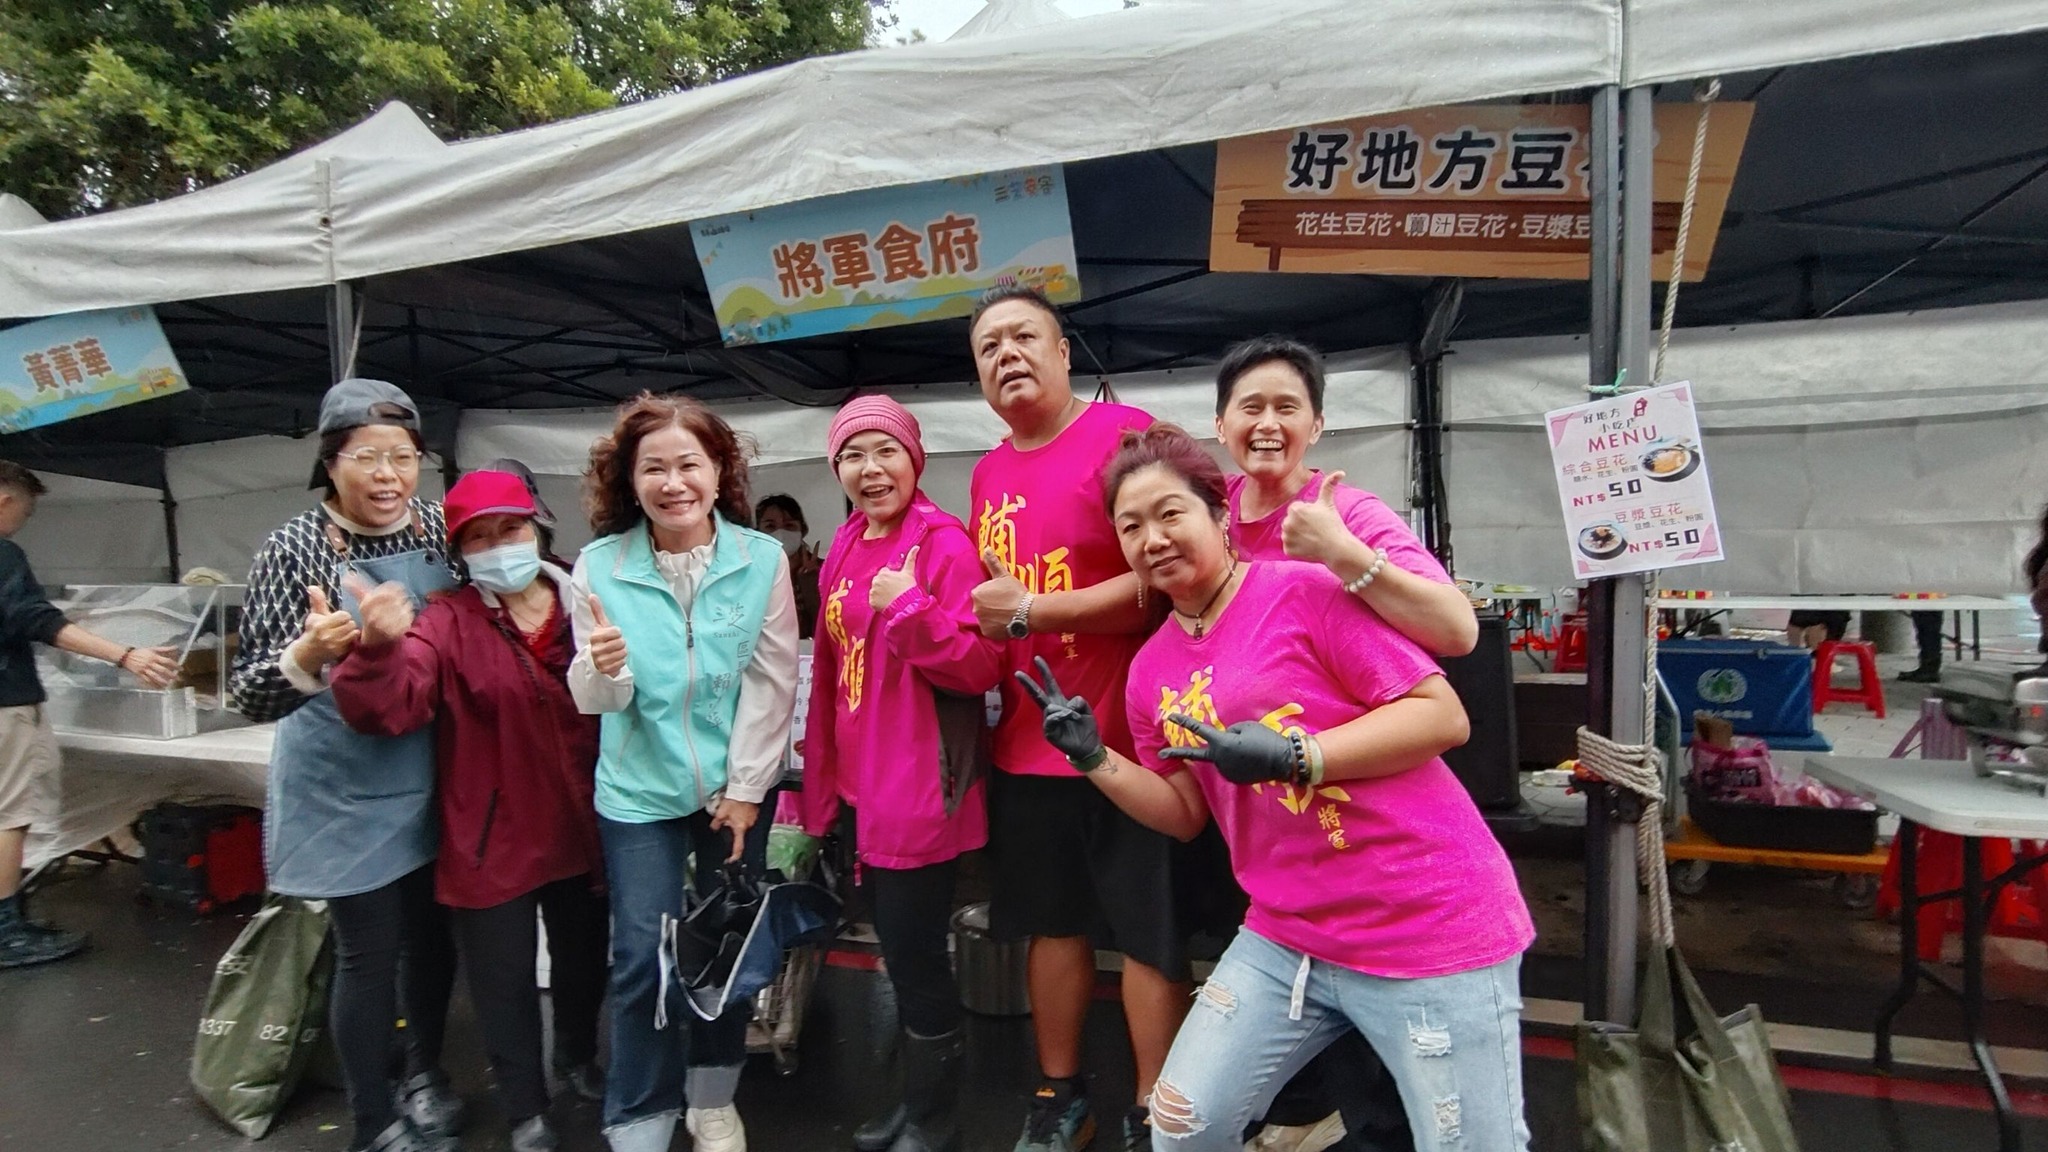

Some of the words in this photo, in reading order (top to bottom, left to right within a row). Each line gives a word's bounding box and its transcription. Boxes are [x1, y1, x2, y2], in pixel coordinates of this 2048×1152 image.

[1288, 128, 1622, 192] 好地方豆
[773, 214, 979, 298] 將軍食府
[23, 337, 112, 393] 黃菁華
[1583, 408, 1620, 424] 好地方
[1588, 425, 1658, 453] MENU
[1562, 454, 1628, 475] 綜合豆花
[1573, 493, 1607, 507] NT$
[1608, 478, 1642, 497] 50
[1614, 502, 1683, 524] 豆漿豆花
[1628, 540, 1664, 553] NT$
[1664, 528, 1700, 547] 50
[1317, 803, 1350, 850] 將軍
[260, 1024, 289, 1042] 82
